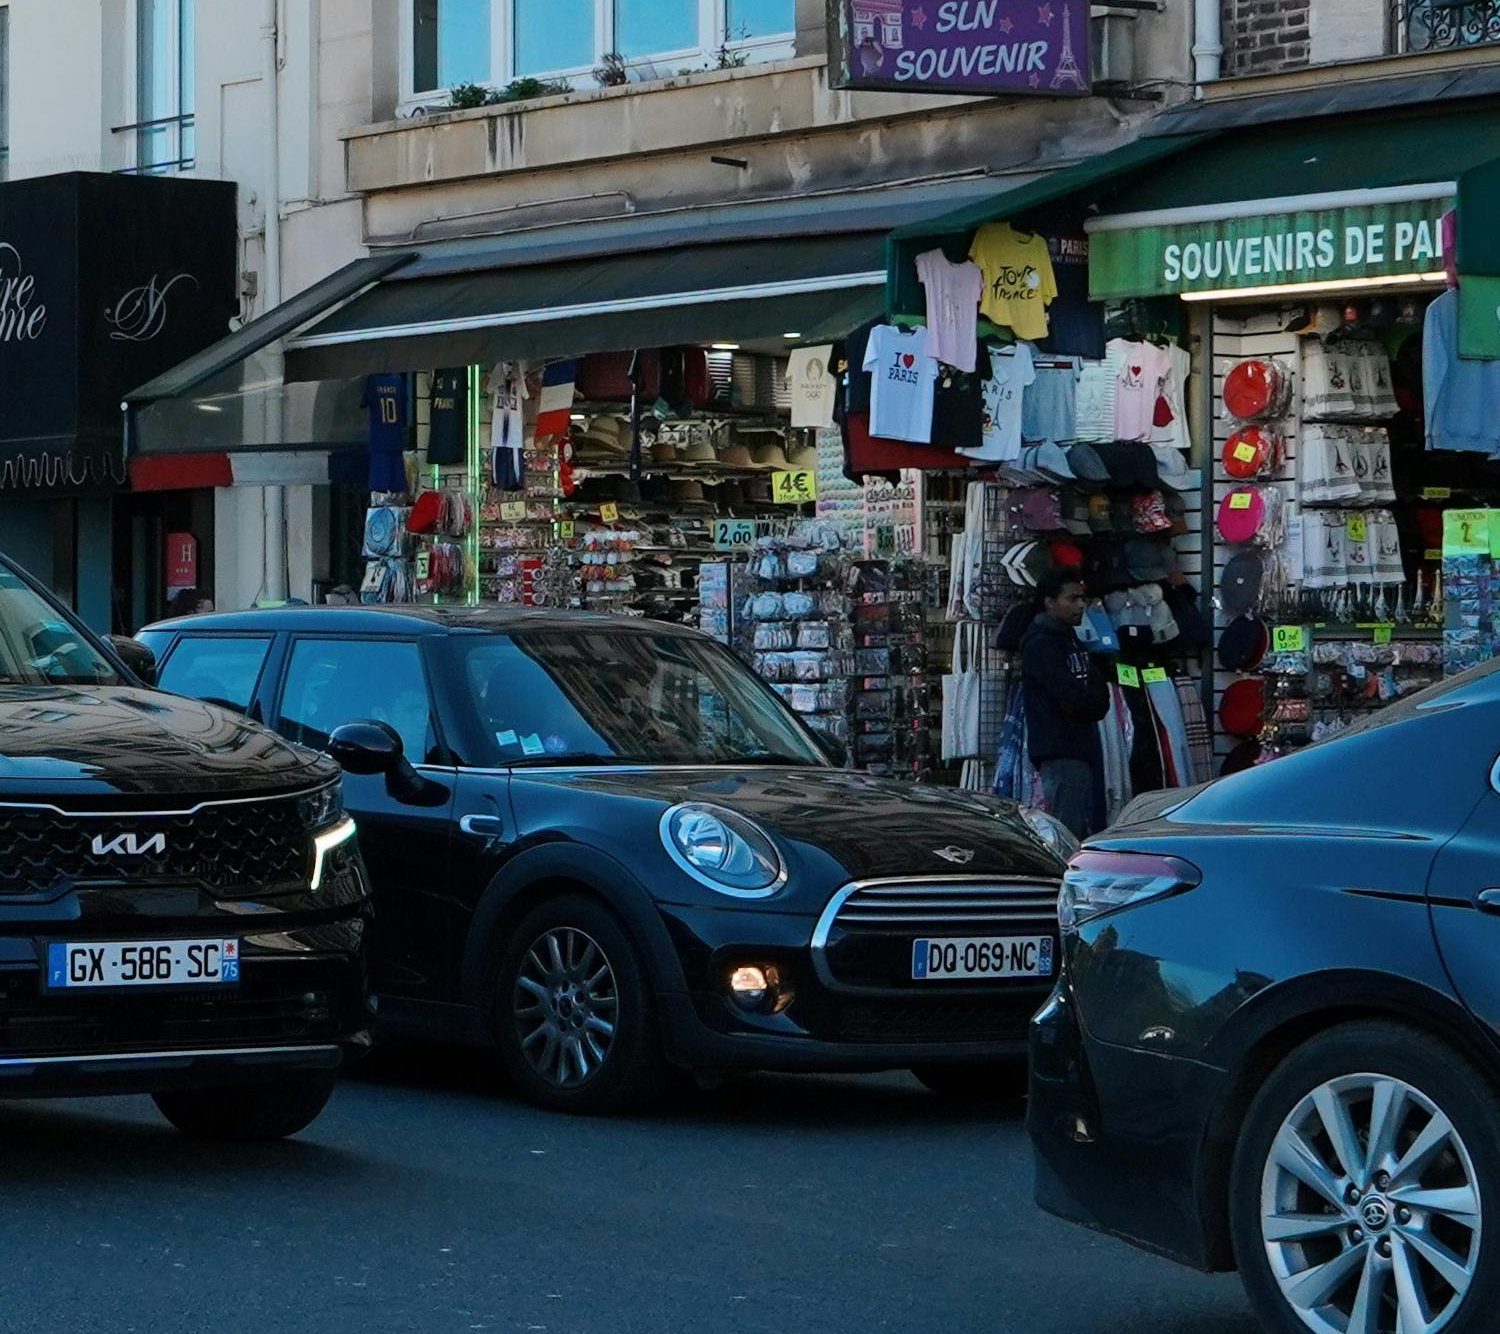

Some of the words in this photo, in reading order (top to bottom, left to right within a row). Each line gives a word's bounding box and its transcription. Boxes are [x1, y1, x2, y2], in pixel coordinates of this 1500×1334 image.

[893, 40, 1049, 82] SOUVENIR
[1163, 228, 1334, 283] SOUVENIRS
[1344, 224, 1386, 266] DE
[893, 352, 902, 368] I
[888, 367, 919, 386] PARIS
[379, 397, 397, 424] 10
[779, 472, 808, 493] 4€
[719, 523, 751, 547] 2,00
[181, 544, 193, 563] H
[91, 832, 166, 856] KIA
[929, 941, 1036, 973] DQ-069-NC
[54, 970, 62, 982] F
[223, 961, 238, 978] 75
